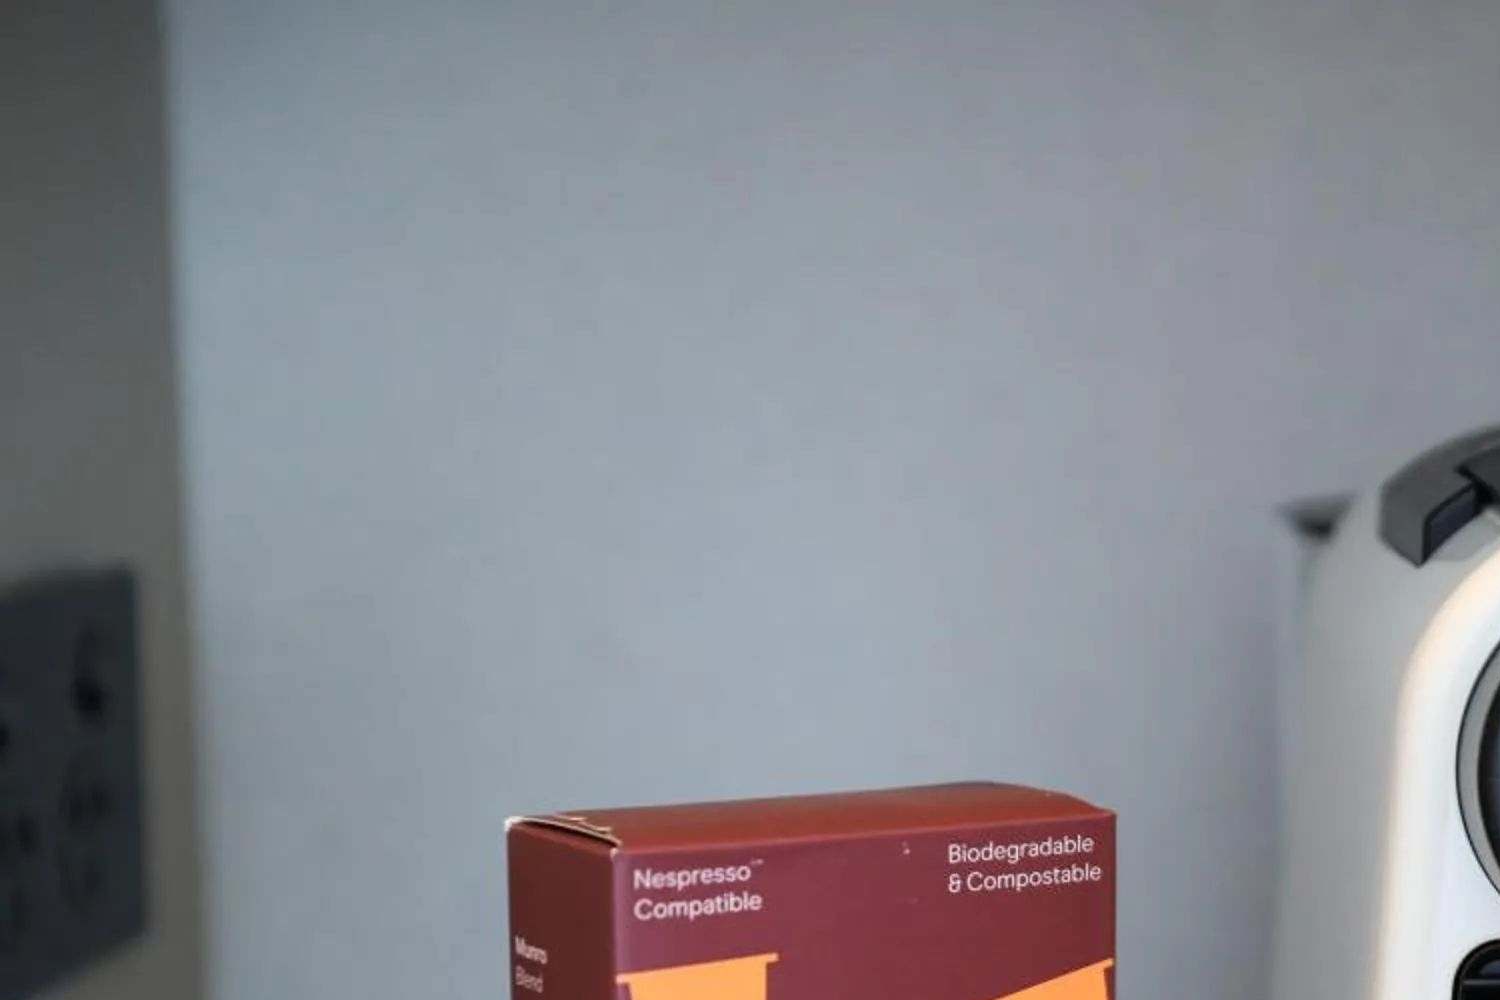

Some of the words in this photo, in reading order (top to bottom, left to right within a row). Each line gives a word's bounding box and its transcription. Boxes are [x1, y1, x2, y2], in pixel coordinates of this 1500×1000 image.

[948, 834, 1095, 865] Biodegradable
[633, 864, 752, 892] Nespresso
[948, 873, 962, 893] &
[966, 863, 1102, 892] Compostable
[633, 891, 763, 921] Compatible
